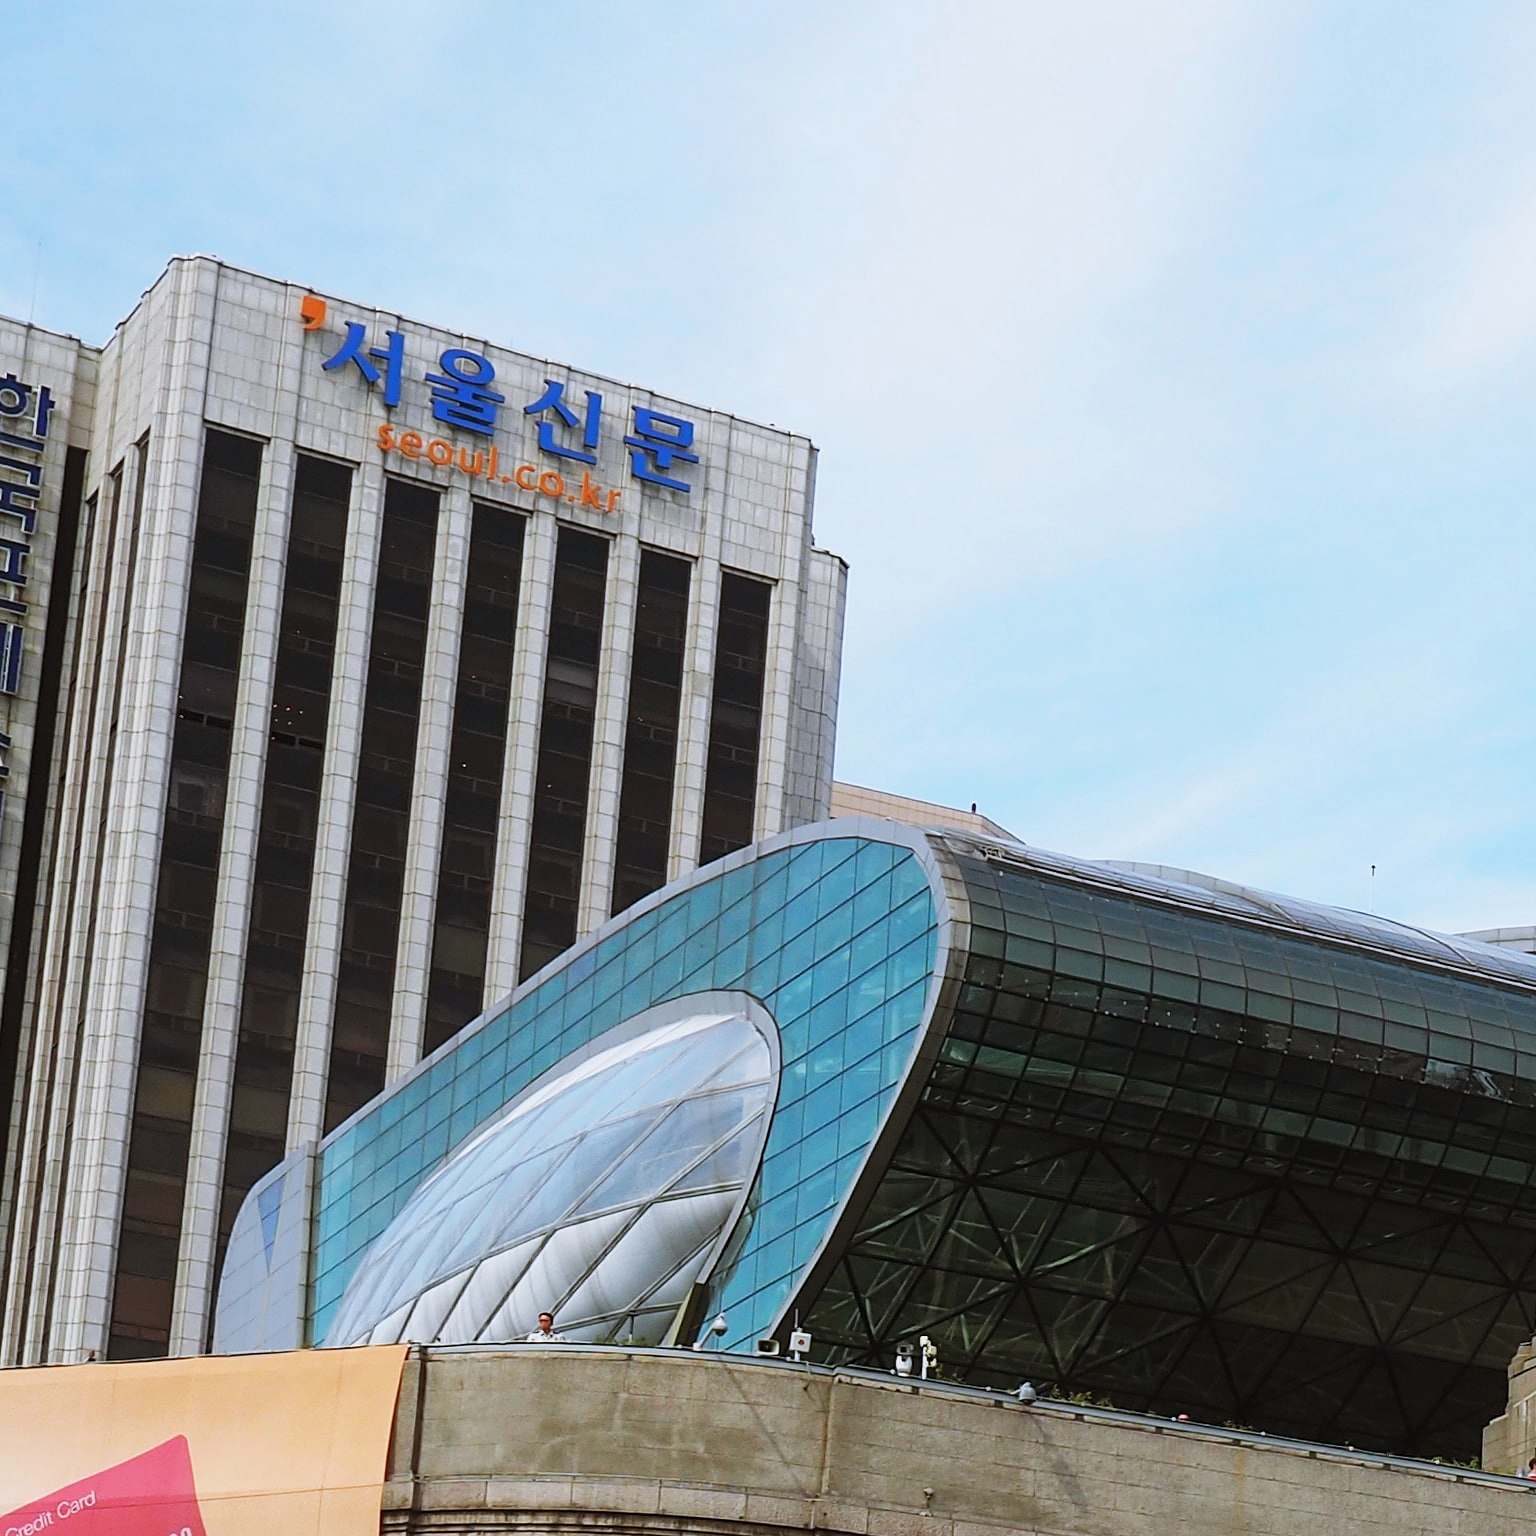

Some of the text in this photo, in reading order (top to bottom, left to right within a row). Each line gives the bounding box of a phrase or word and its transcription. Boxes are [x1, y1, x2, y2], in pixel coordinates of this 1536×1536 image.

[321, 320, 700, 494] 서울신문
[378, 421, 621, 513] seoul.co.kr
[56, 1490, 98, 1522] Card
